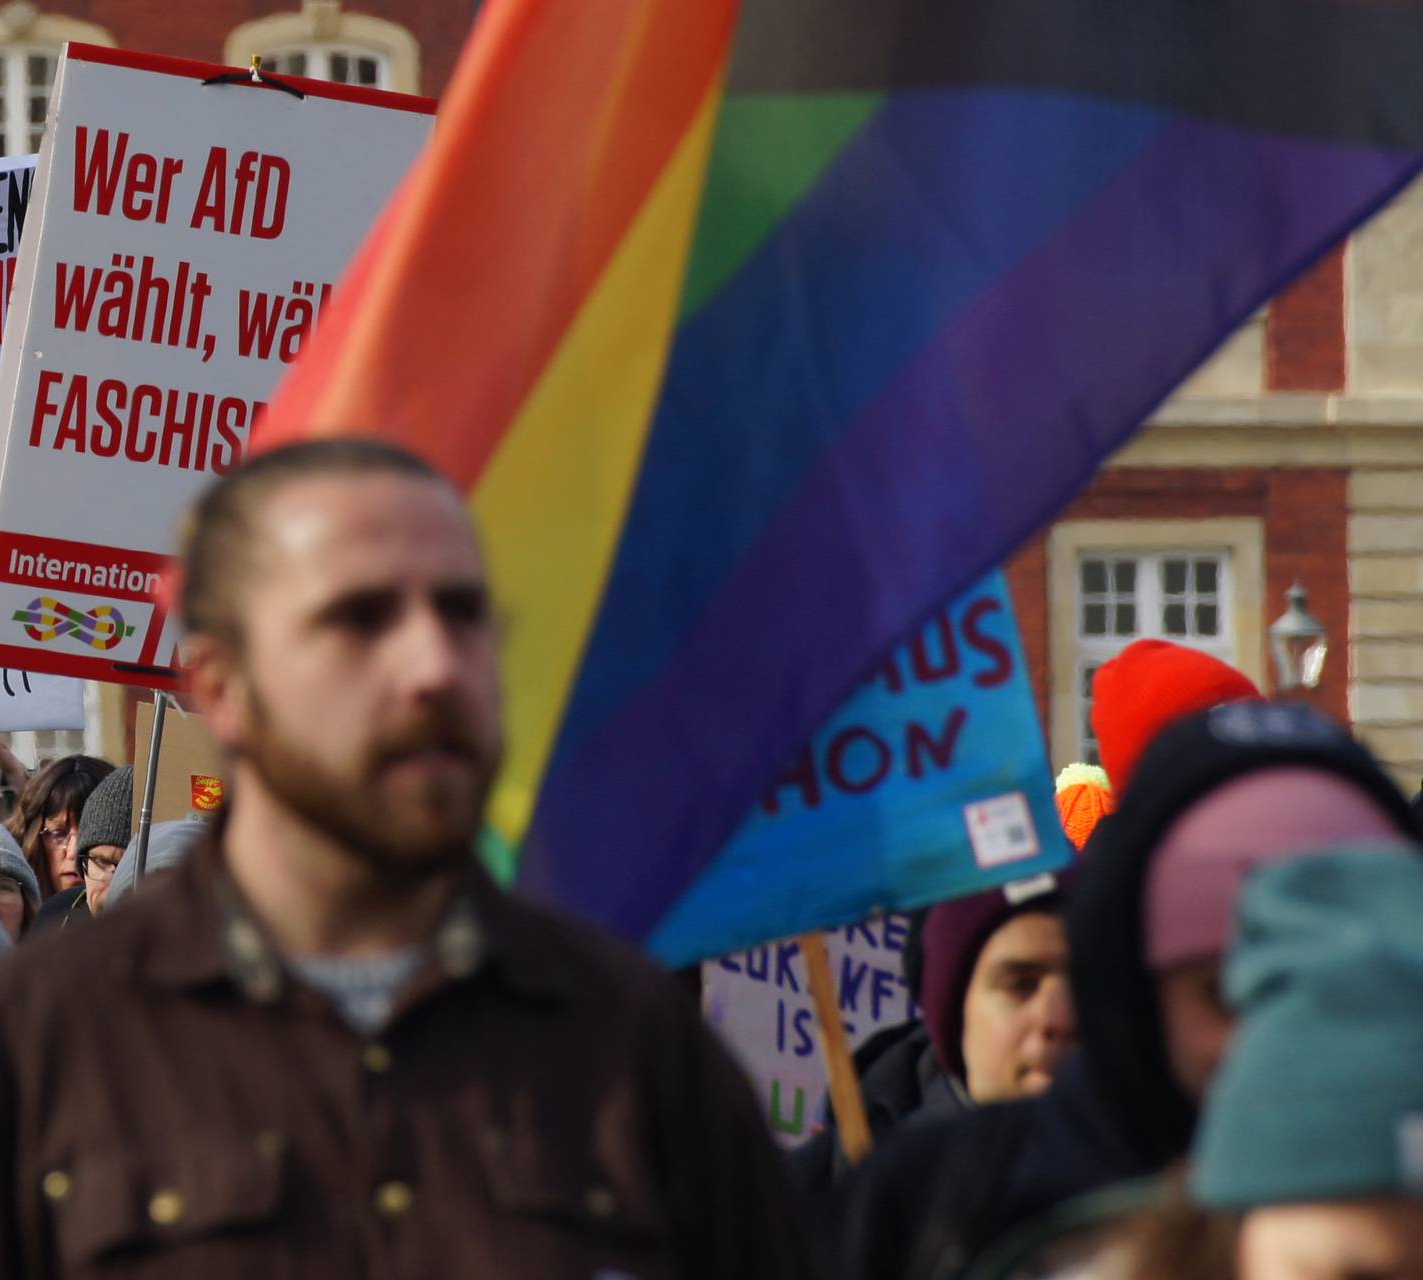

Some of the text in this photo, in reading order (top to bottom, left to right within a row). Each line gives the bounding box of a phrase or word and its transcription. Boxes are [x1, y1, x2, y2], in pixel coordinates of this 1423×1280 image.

[72, 124, 292, 241] Wer AfD
[54, 252, 217, 363] wählt,
[29, 369, 269, 478] FASCHIS
